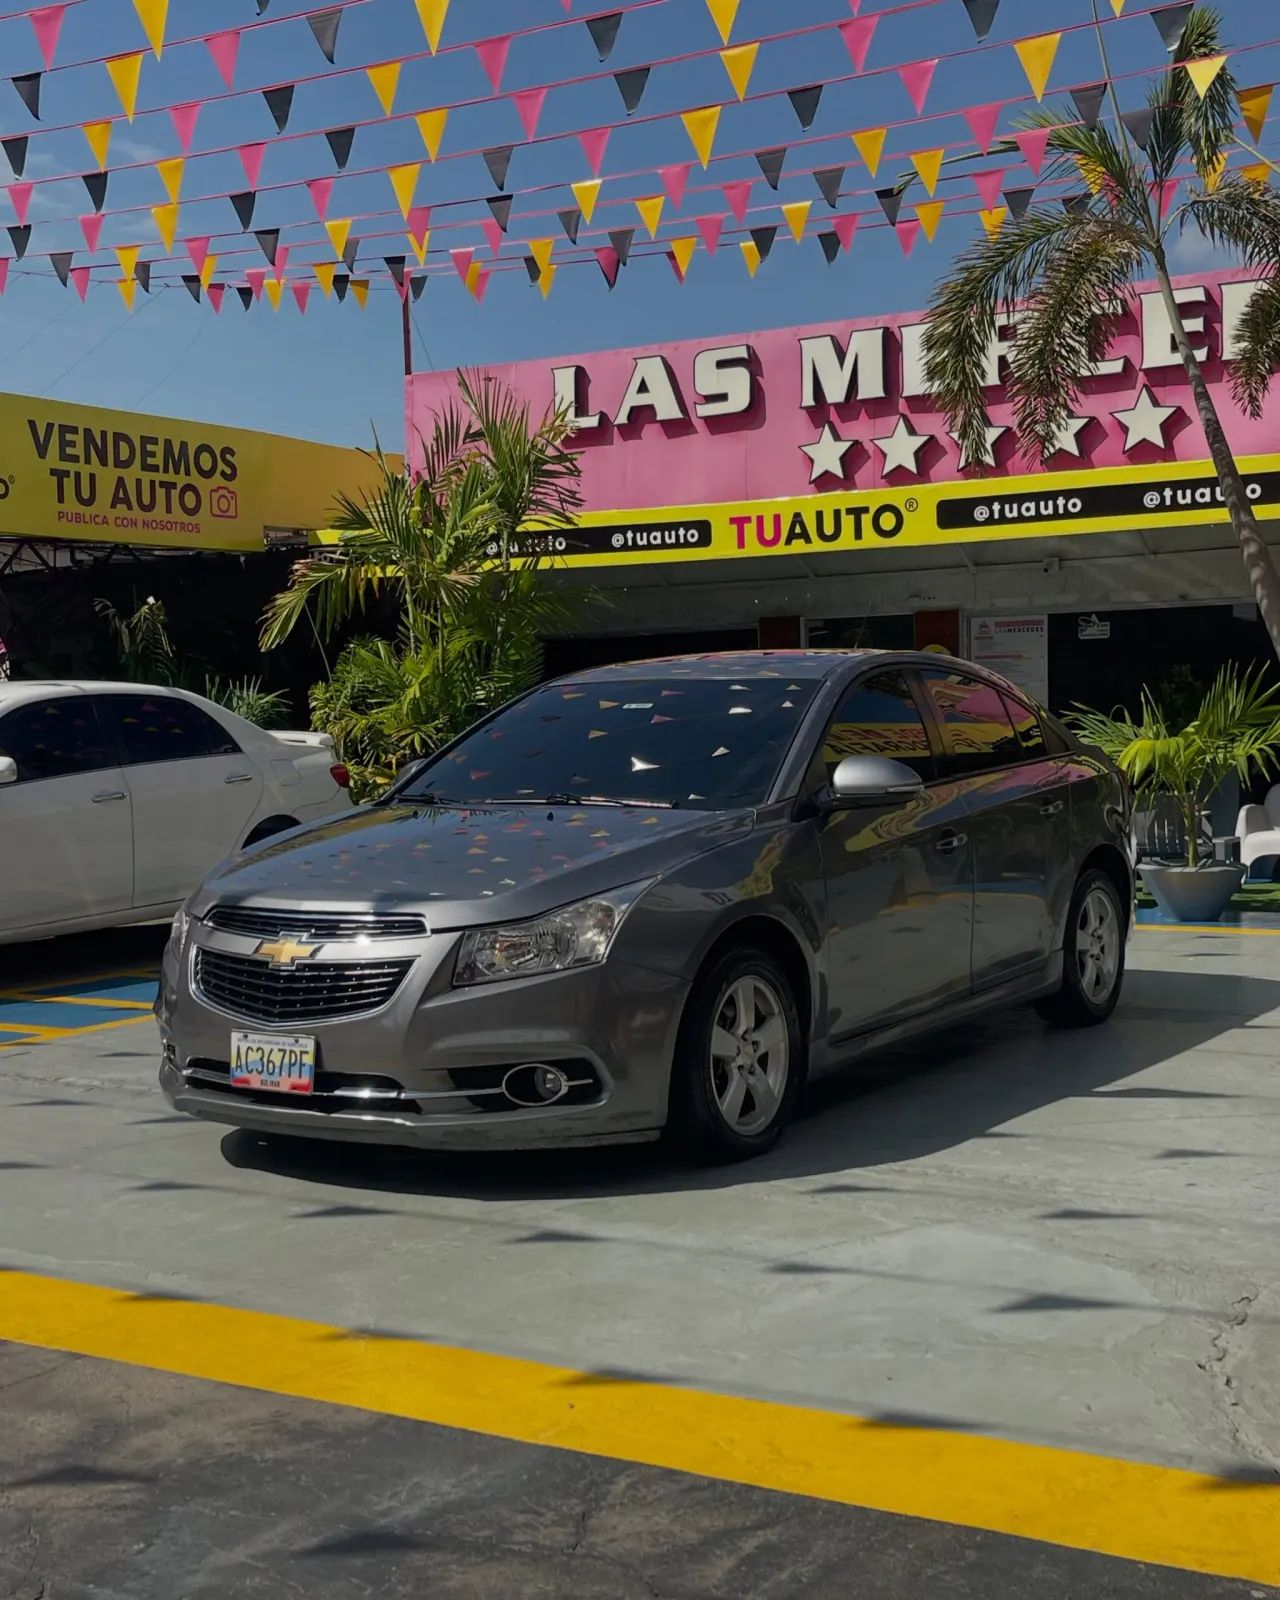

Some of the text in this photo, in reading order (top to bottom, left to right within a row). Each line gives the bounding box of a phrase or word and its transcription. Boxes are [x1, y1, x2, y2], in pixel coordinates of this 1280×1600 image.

[551, 344, 755, 430] LAS
[27, 419, 238, 482] VENDEMOS
[50, 468, 97, 507] TU
[110, 476, 202, 517] AUTO
[1143, 483, 1262, 508] @tuauo
[57, 511, 201, 534] PUBLICA CON NOSOTROS
[973, 497, 1082, 522] @tuauto
[611, 525, 700, 548] @tuauto
[235, 1044, 310, 1079] AC367PF
